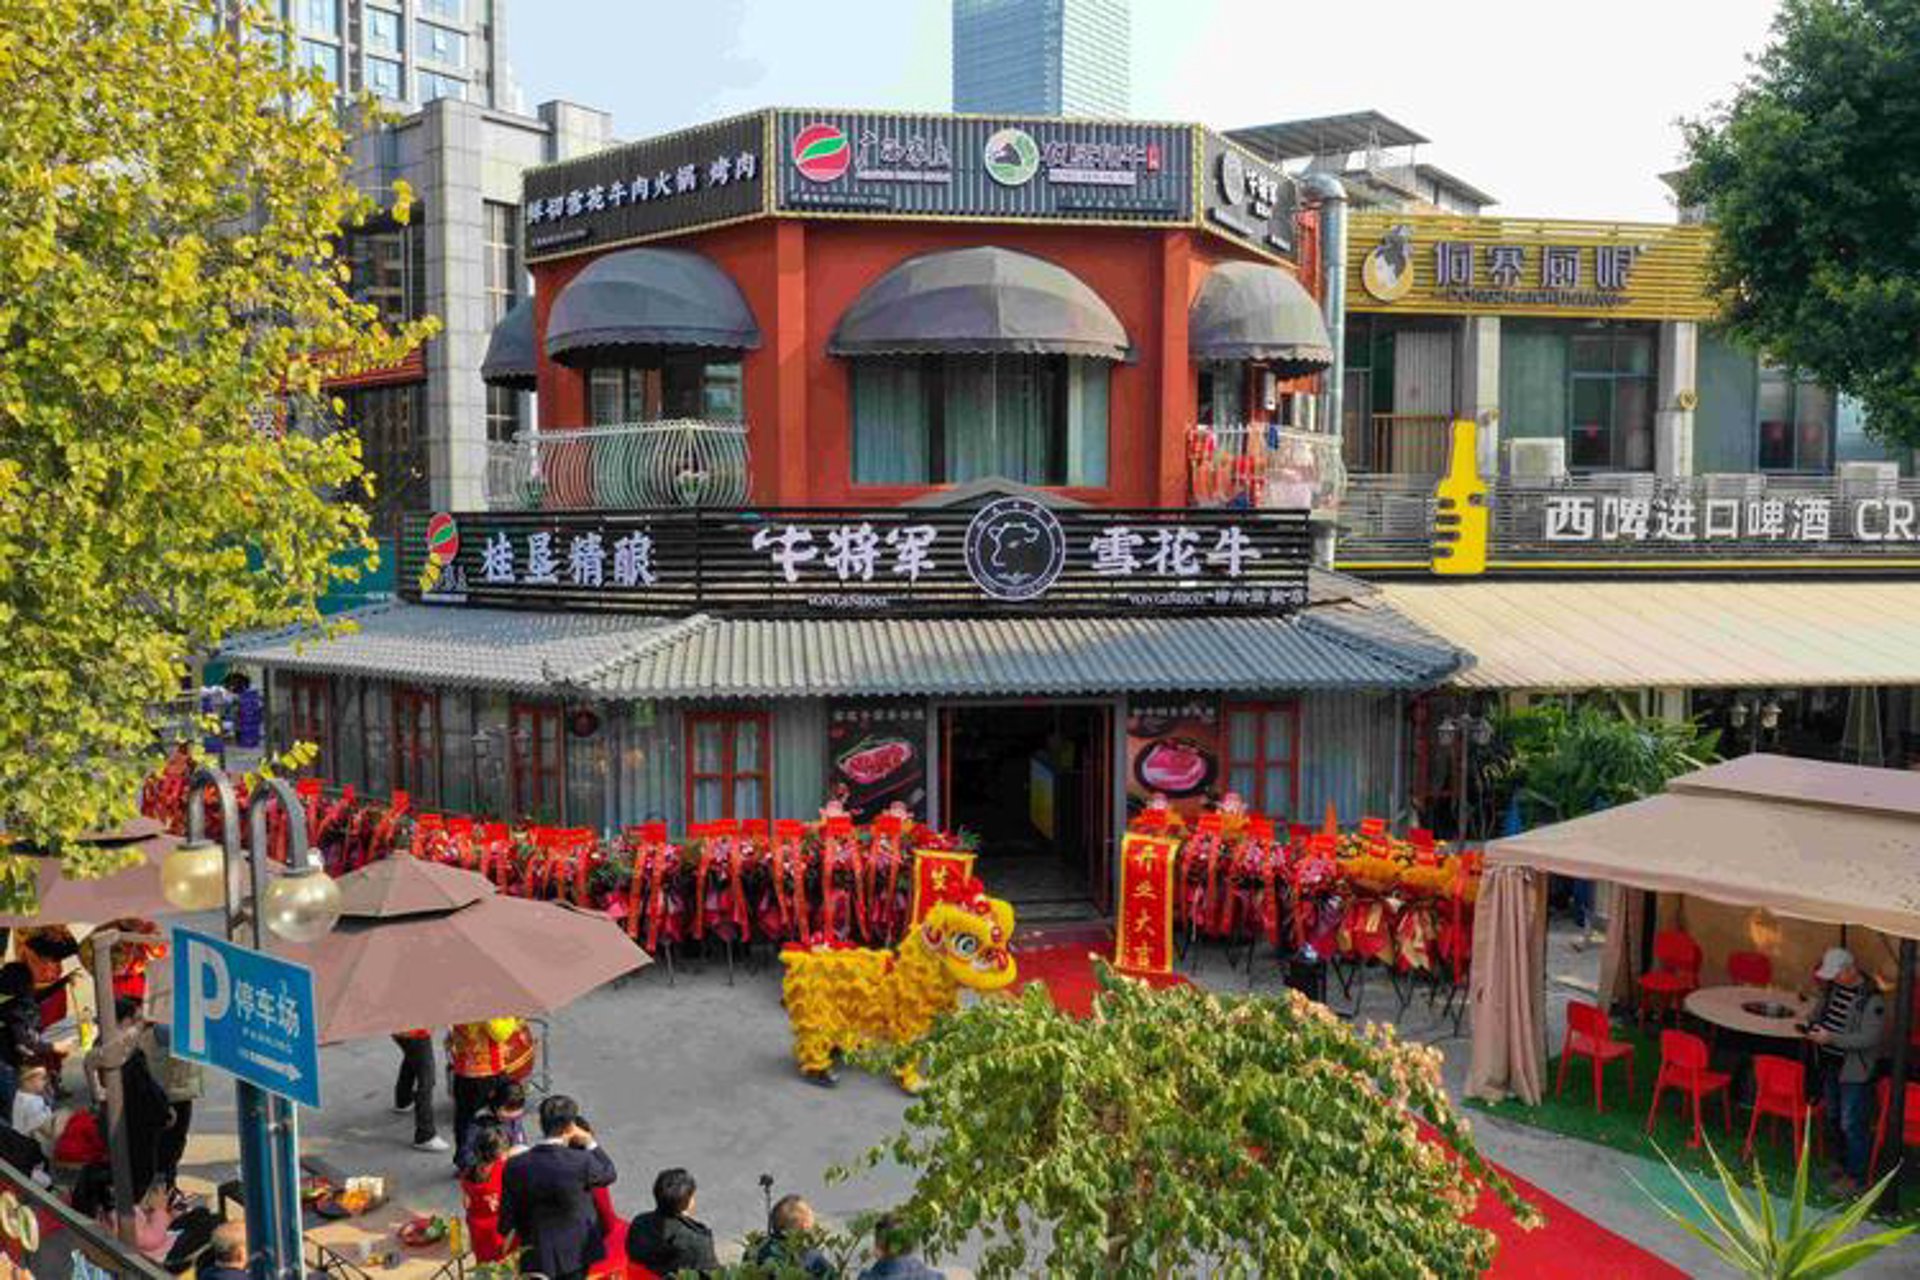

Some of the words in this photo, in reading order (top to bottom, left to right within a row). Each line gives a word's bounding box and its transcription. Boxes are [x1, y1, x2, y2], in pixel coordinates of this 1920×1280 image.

[1856, 498, 1920, 541] CR
[1089, 526, 1261, 577] 雪花牛
[188, 940, 231, 1053] P
[235, 979, 300, 1038] 停车场
